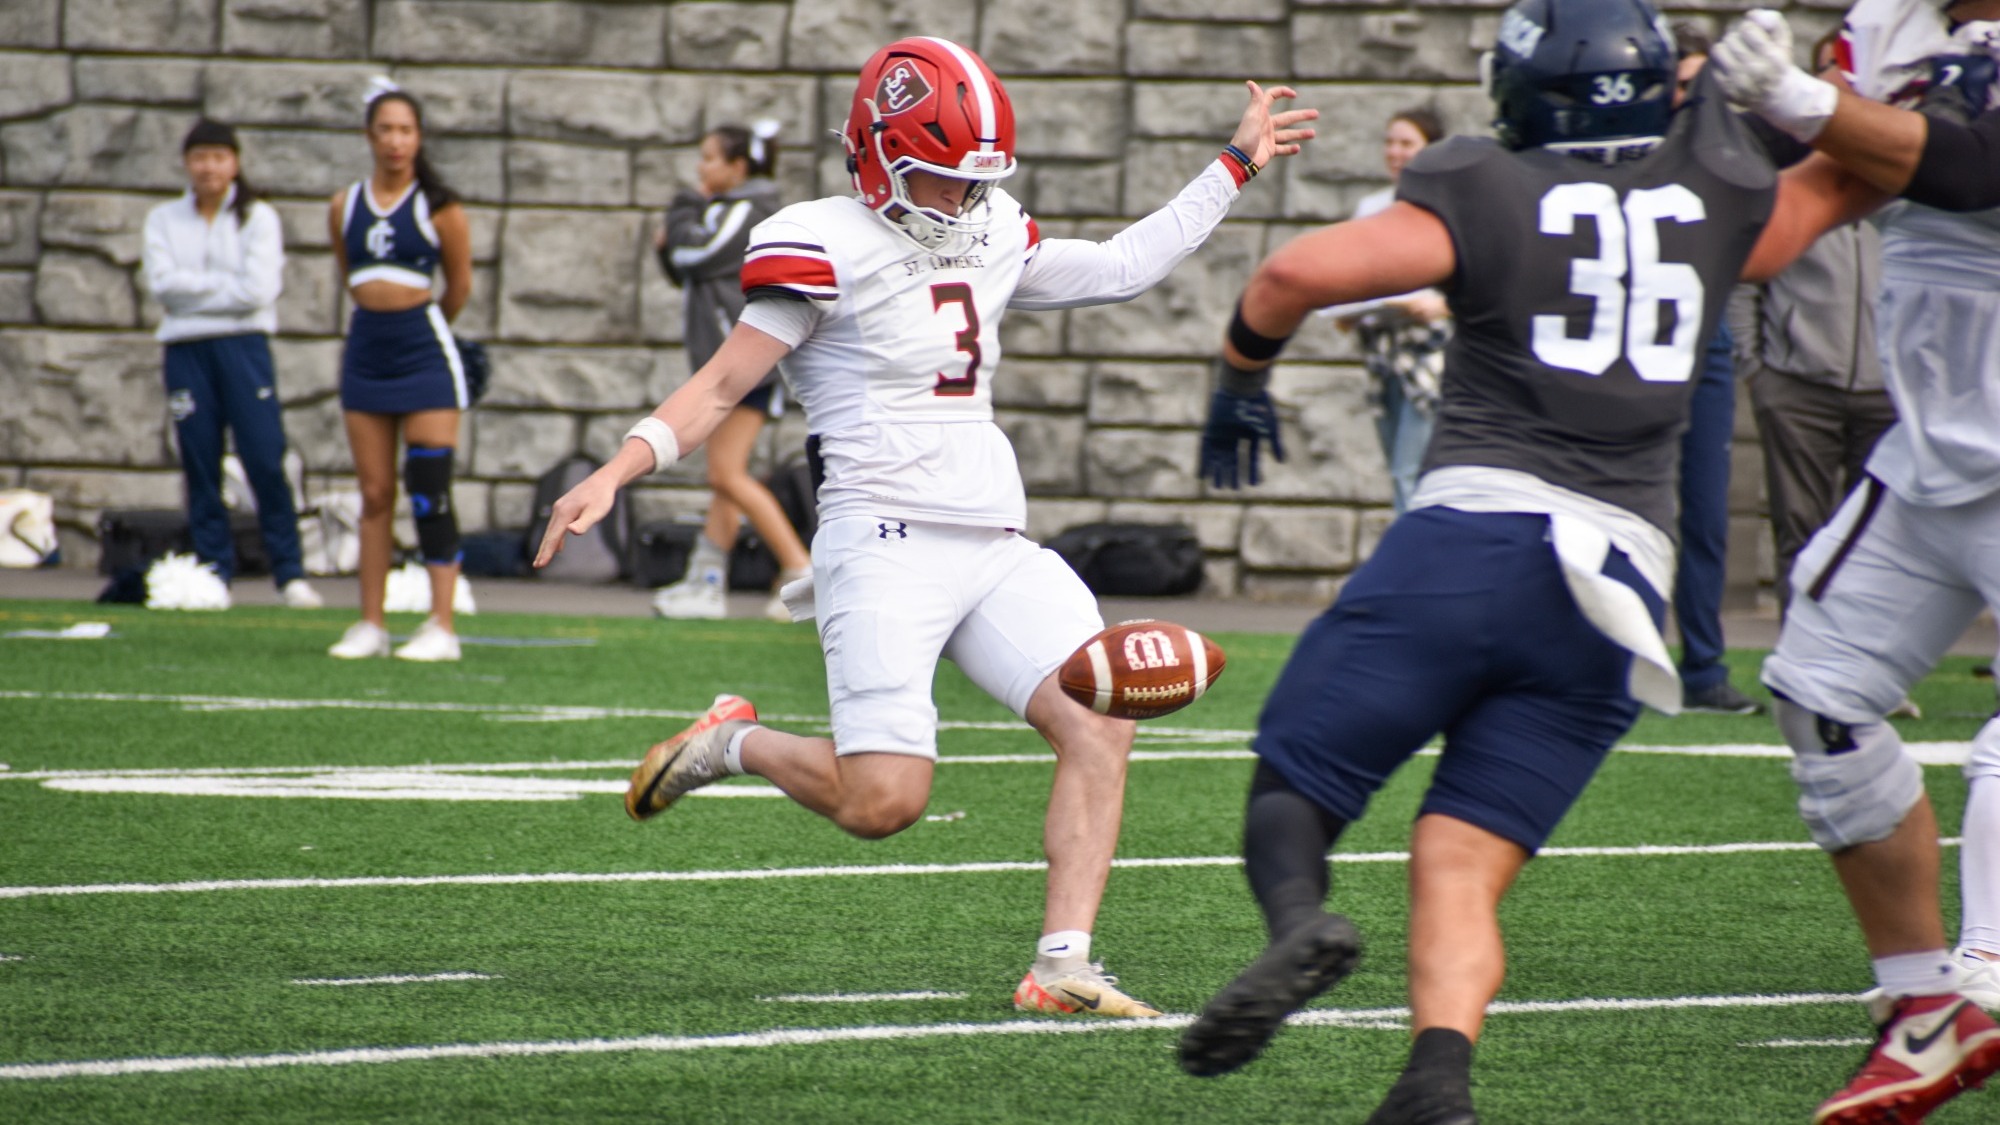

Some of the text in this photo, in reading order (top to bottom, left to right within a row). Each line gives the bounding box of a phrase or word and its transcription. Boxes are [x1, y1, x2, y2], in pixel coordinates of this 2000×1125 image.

[1591, 73, 1634, 104] 36
[974, 156, 1000, 168] SAINTS
[928, 255, 984, 270] LAWRENCE
[1532, 182, 1706, 381] 36
[930, 282, 982, 396] 3
